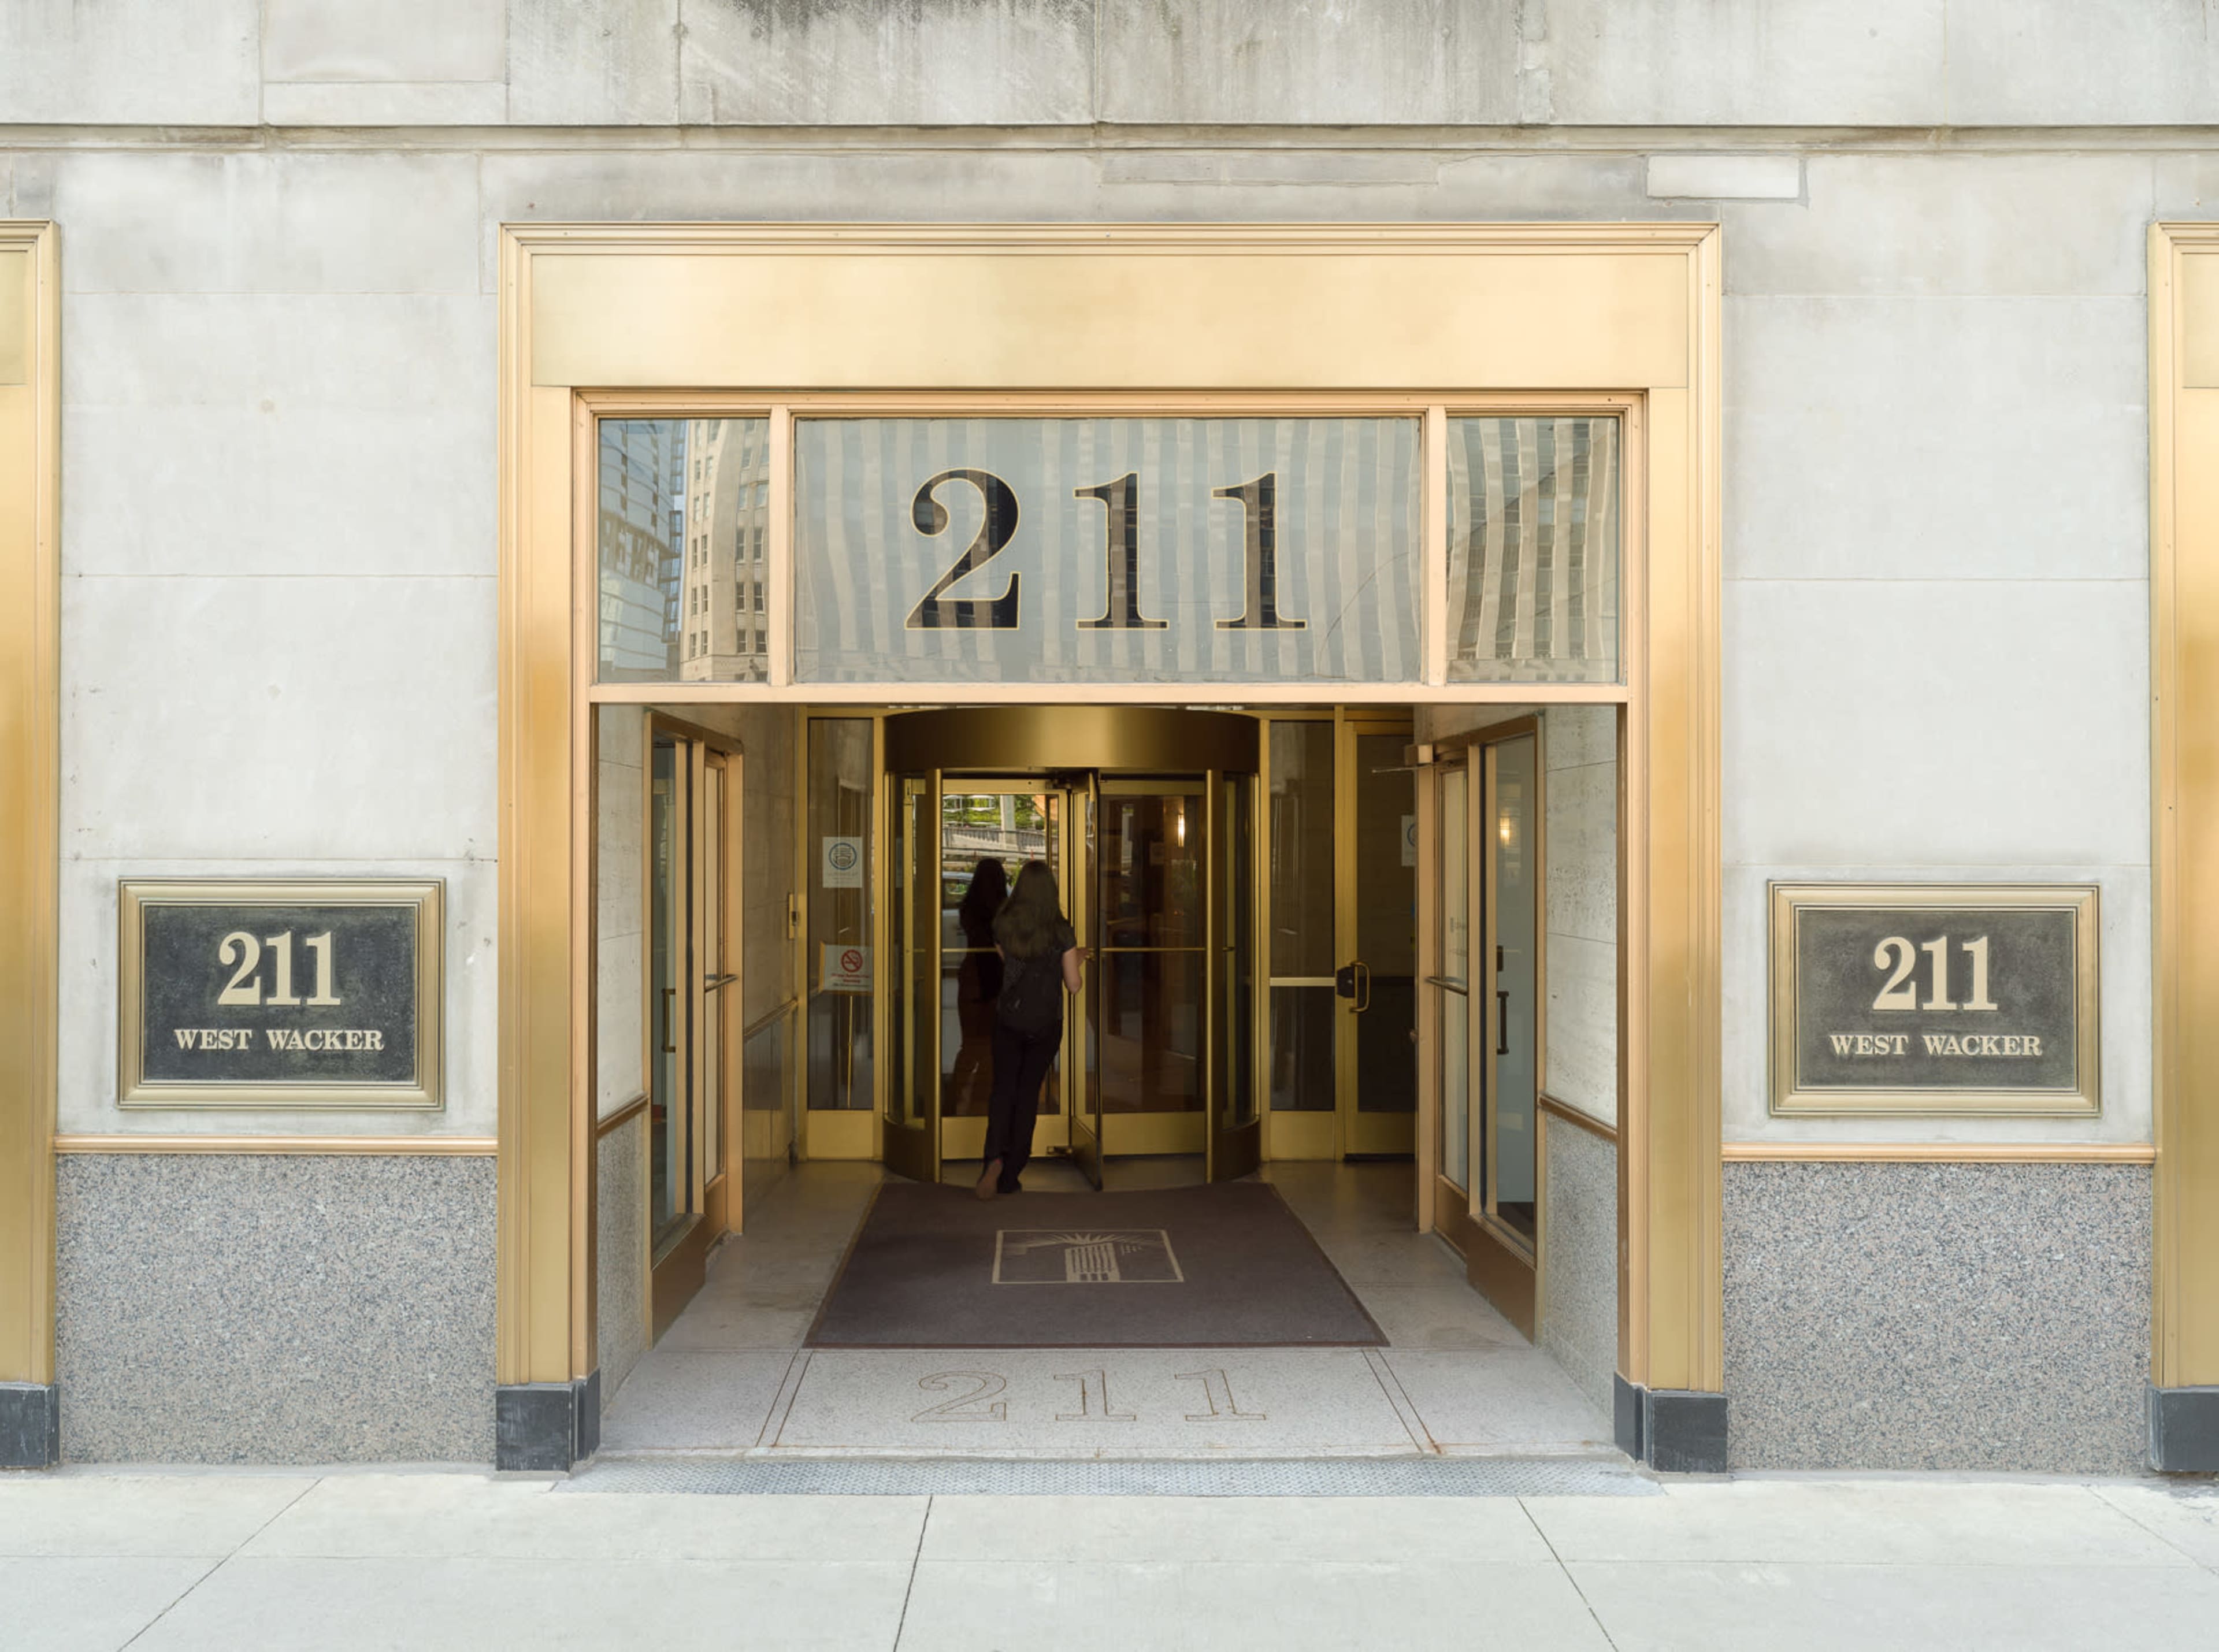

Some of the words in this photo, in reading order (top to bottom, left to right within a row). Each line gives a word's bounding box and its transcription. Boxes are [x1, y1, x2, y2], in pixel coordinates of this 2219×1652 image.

[905, 467, 1307, 630] 211
[217, 931, 341, 1005] 211
[1873, 935, 1997, 1010] 211
[175, 1029, 252, 1050] WEST
[266, 1030, 384, 1050] WACKER
[1831, 1035, 1908, 1055] WEST
[1923, 1035, 2042, 1056] WACKER
[911, 1369, 1266, 1421] 211
